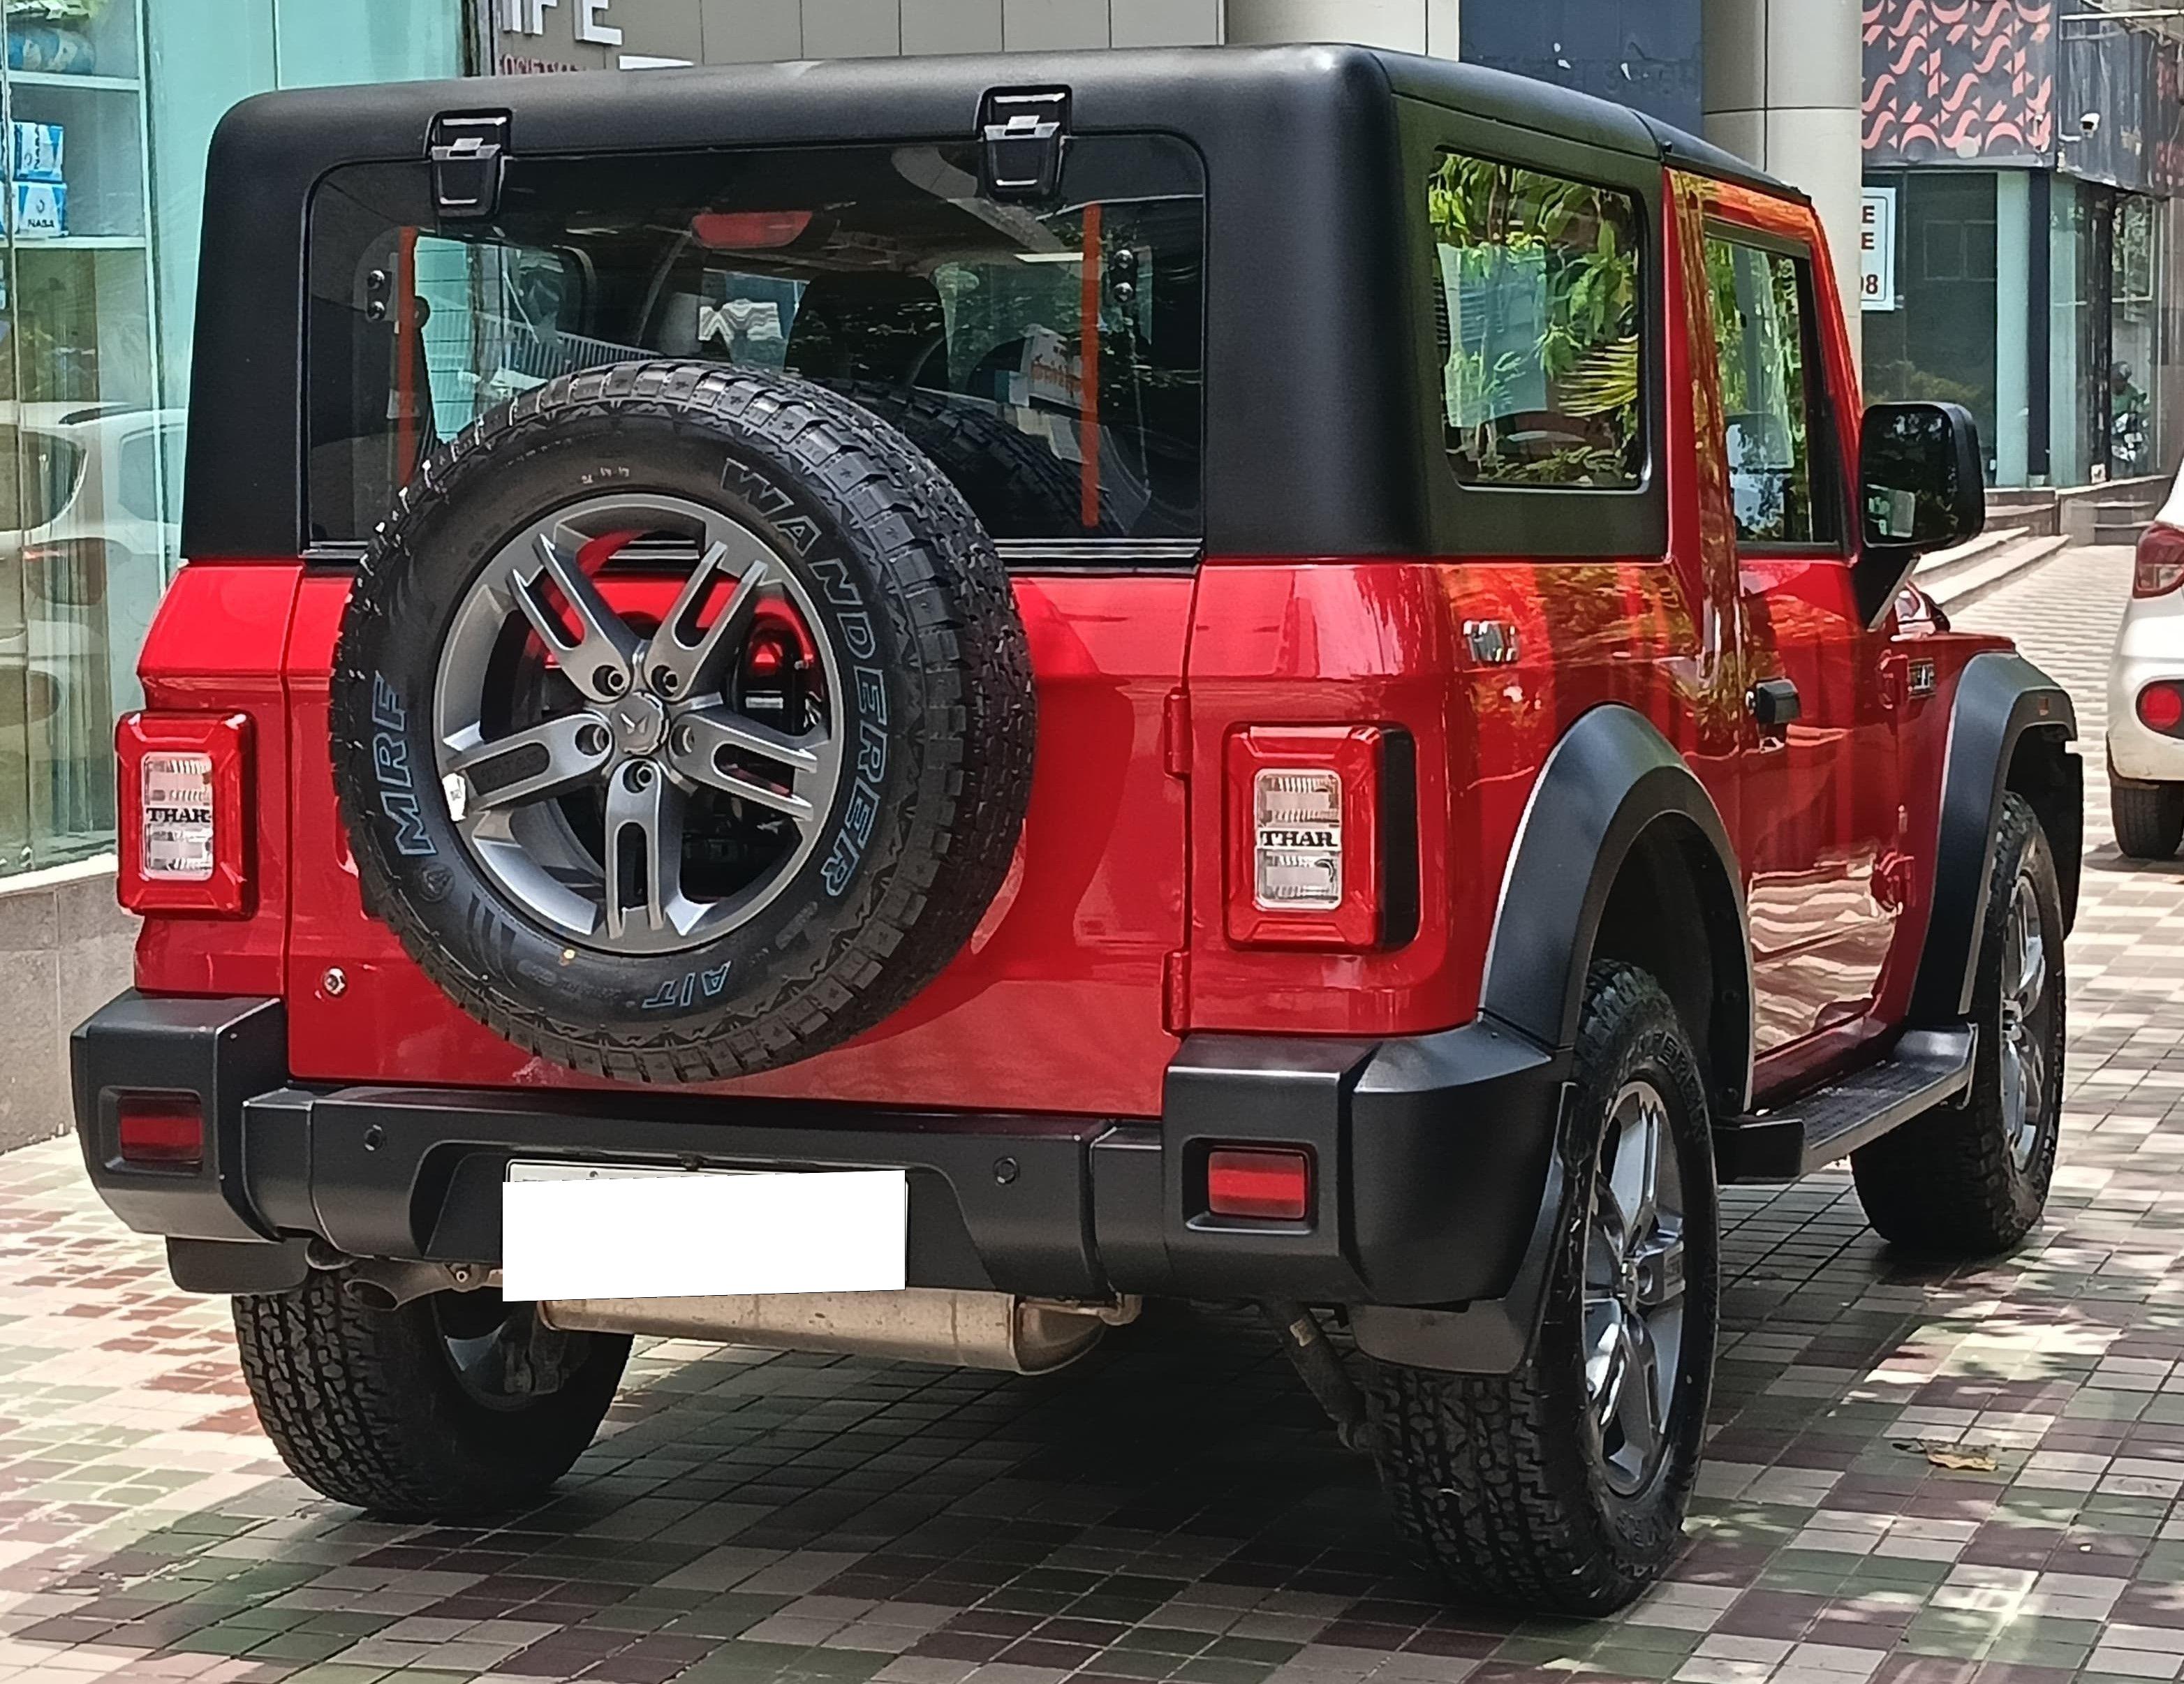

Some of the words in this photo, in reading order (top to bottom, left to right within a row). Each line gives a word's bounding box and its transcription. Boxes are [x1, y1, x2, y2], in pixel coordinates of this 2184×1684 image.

[372, 670, 437, 855] MRF
[721, 457, 887, 896] WANDERER
[1260, 830, 1338, 848] THAR
